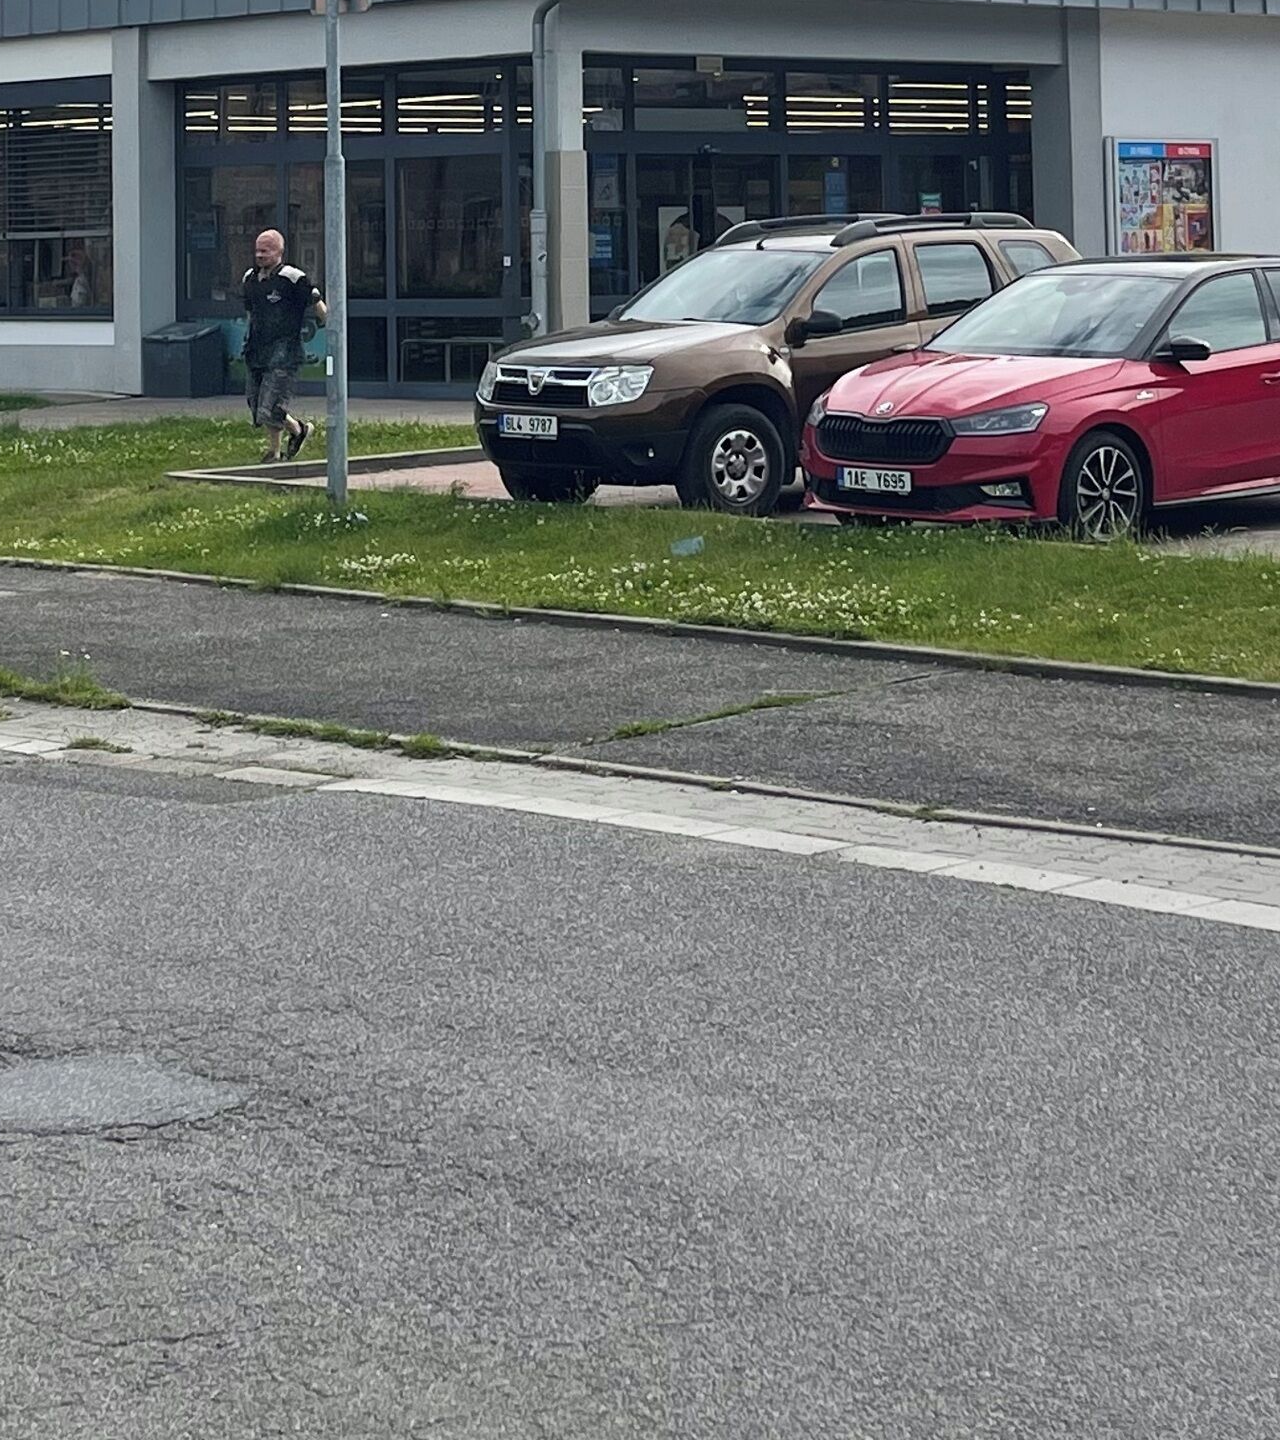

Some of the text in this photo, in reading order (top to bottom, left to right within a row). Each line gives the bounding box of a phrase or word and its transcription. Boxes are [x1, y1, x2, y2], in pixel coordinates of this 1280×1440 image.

[528, 417, 553, 433] 9787
[847, 470, 906, 490] 1AE Y695
